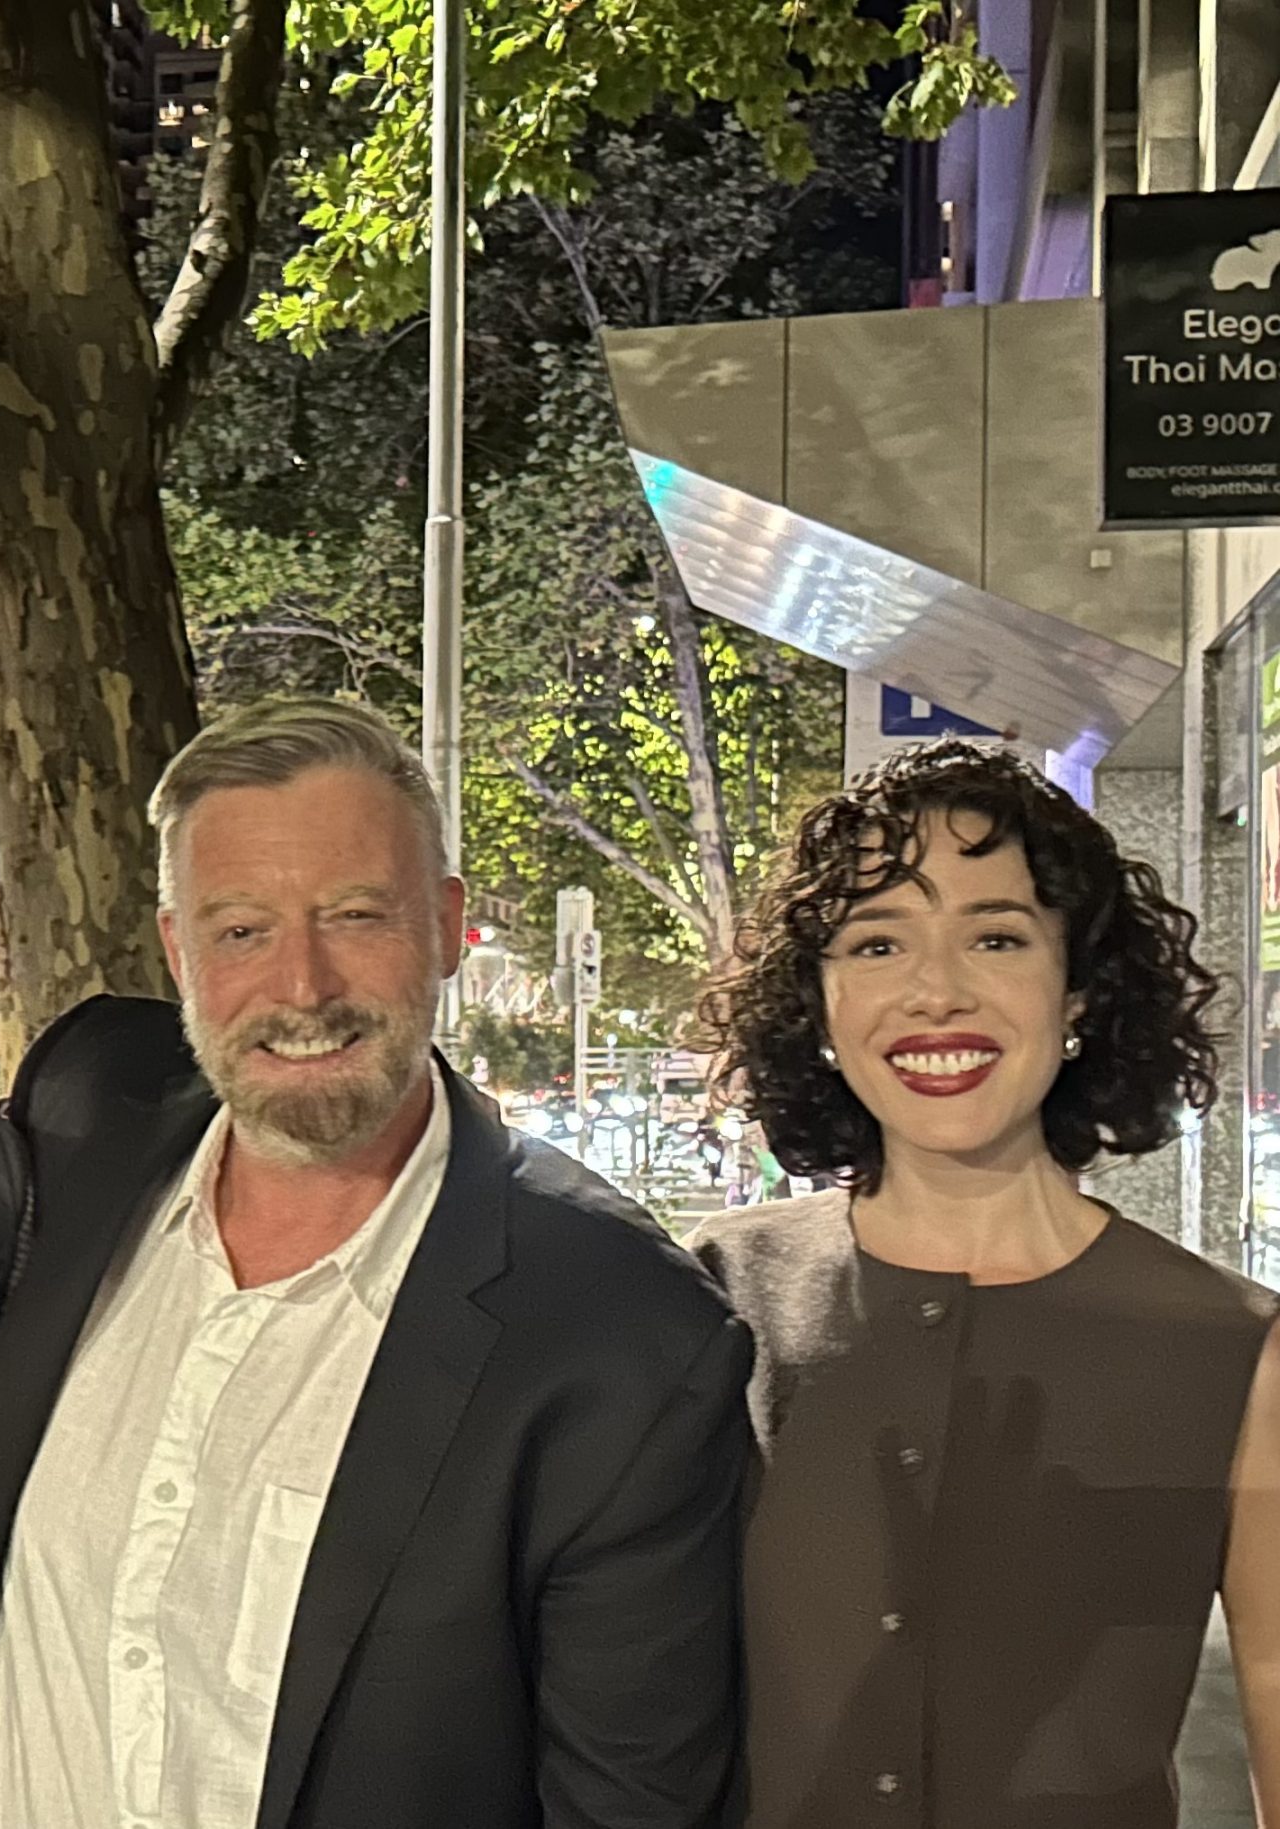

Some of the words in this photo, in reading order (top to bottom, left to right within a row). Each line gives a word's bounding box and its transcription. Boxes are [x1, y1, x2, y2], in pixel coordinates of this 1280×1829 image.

[1123, 354, 1206, 384] Thai
[1219, 352, 1280, 382] Ma
[1158, 414, 1194, 437] 03
[1202, 411, 1274, 436] 9007
[1169, 465, 1207, 478] FOOT
[1210, 463, 1278, 477] MASSAGE
